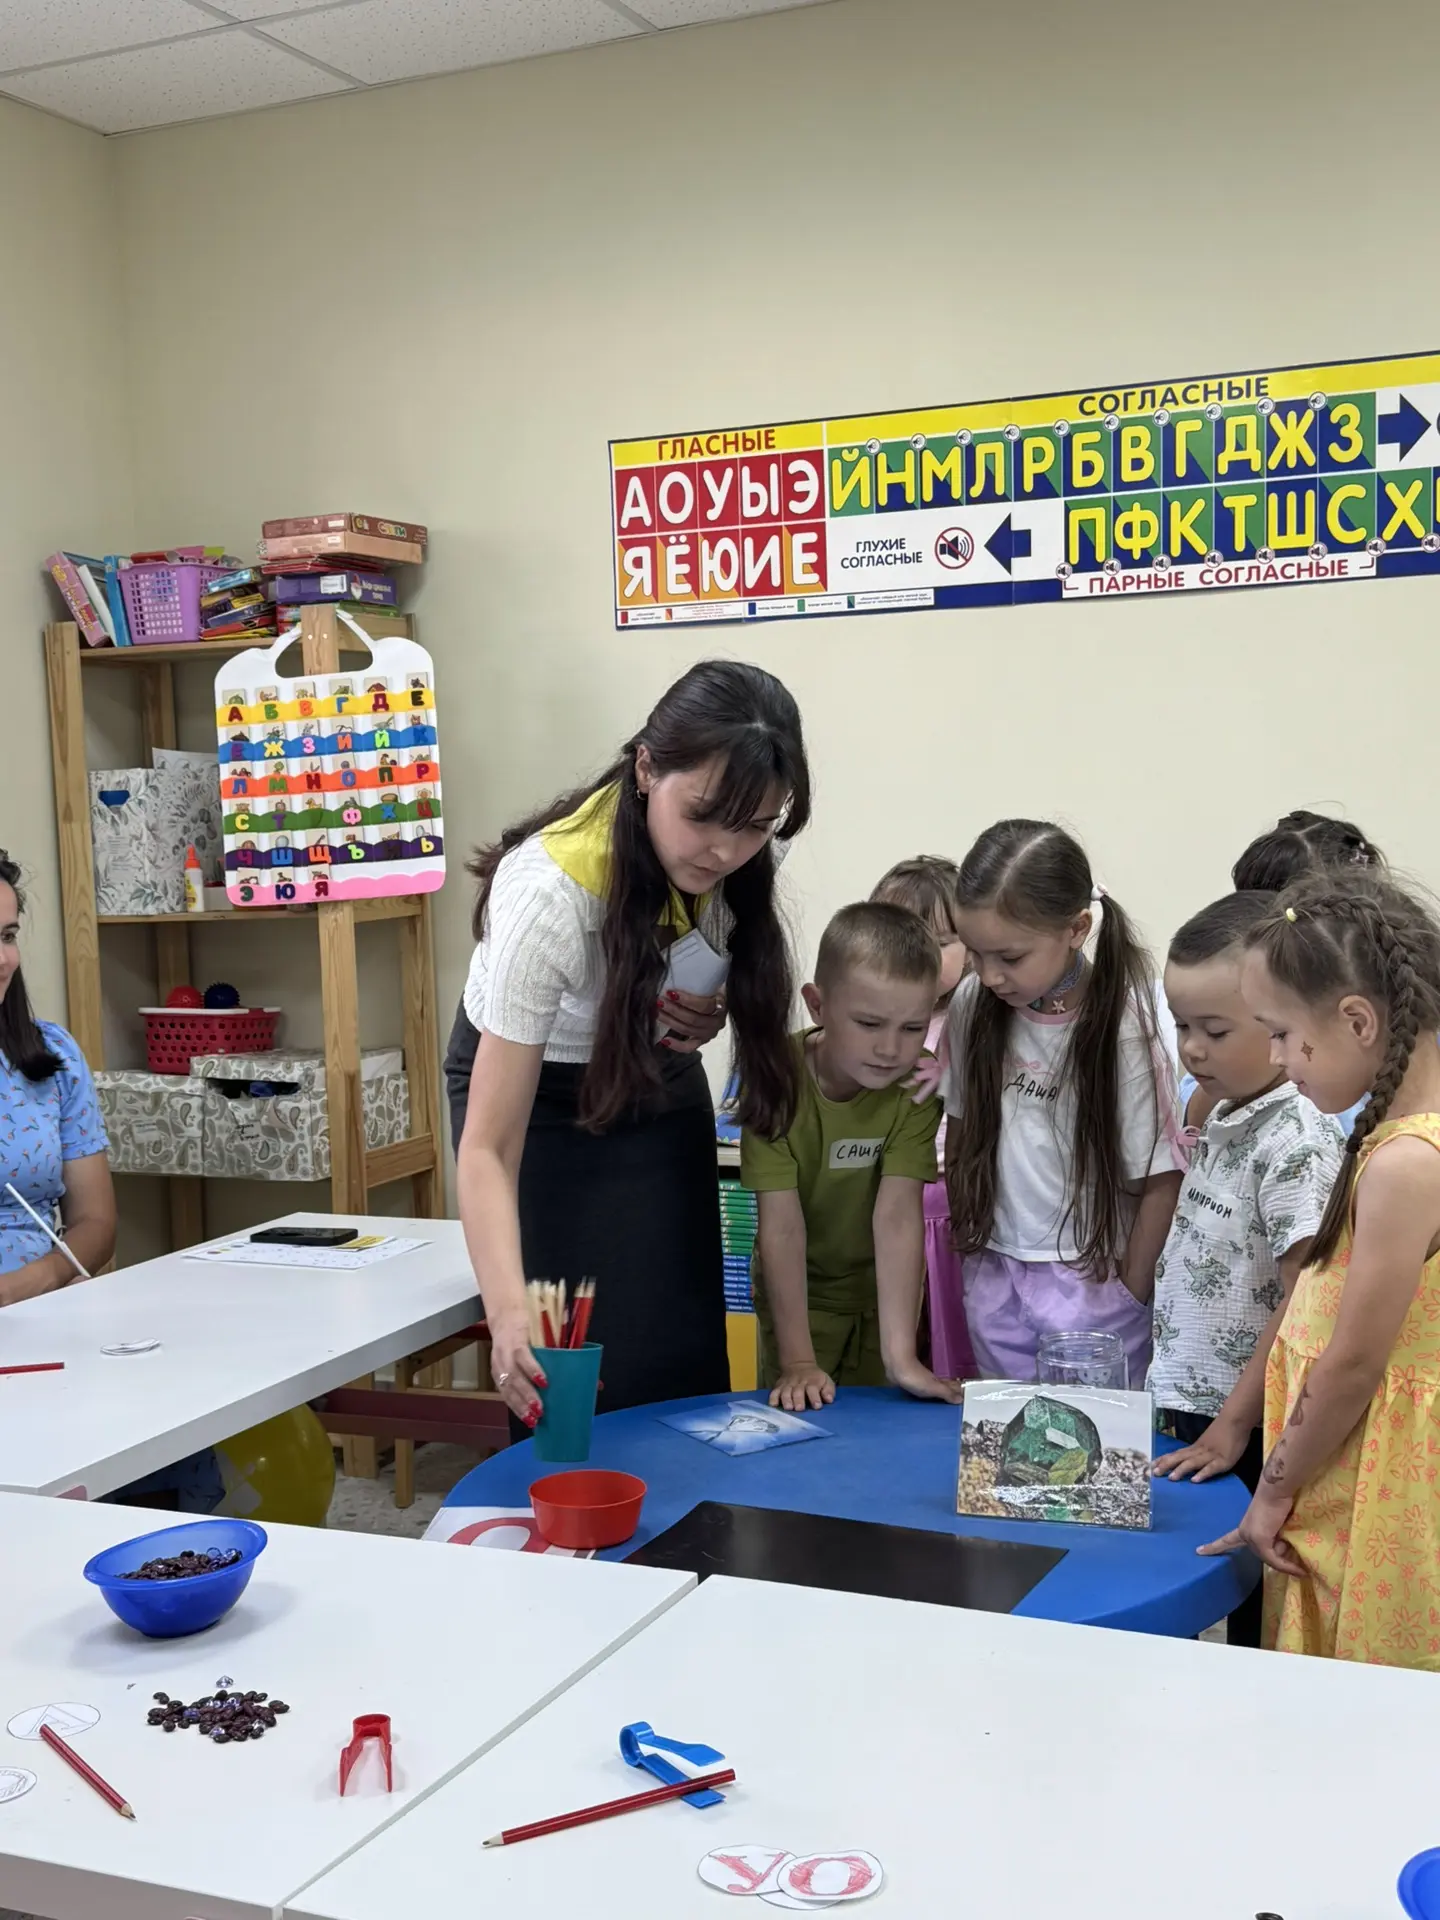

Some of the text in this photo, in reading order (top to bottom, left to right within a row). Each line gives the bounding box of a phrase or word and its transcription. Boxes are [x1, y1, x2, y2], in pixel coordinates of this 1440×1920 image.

[1078, 376, 1270, 416] СОГЛАСНЫЕ
[657, 428, 777, 461] ГЛАСНЫЕ
[840, 550, 924, 570] СОГЛАСНЫЕ
[855, 537, 907, 553] ГЛУХИЕ
[1088, 558, 1349, 595] ПАРНЫЕ СОГЛАСНЫЕ
[228, 690, 425, 722] А Б В Г Д Е
[264, 740, 285, 757] Ж
[302, 737, 315, 754] З
[337, 733, 352, 750] И
[375, 729, 390, 748] Й
[232, 763, 430, 795] Л М Н О П Р
[235, 813, 250, 830] С
[272, 813, 286, 829] Т
[342, 807, 362, 825] Ф
[382, 804, 396, 820] Х
[417, 800, 432, 817] Ц
[236, 851, 253, 866] Ч
[271, 848, 293, 865] Ш
[308, 846, 332, 864] Щ
[347, 844, 365, 860] Ъ
[421, 837, 435, 853] Ь
[240, 881, 329, 902] Э Ю Я
[1003, 1072, 1058, 1102] ДАША
[836, 1143, 882, 1160] САША
